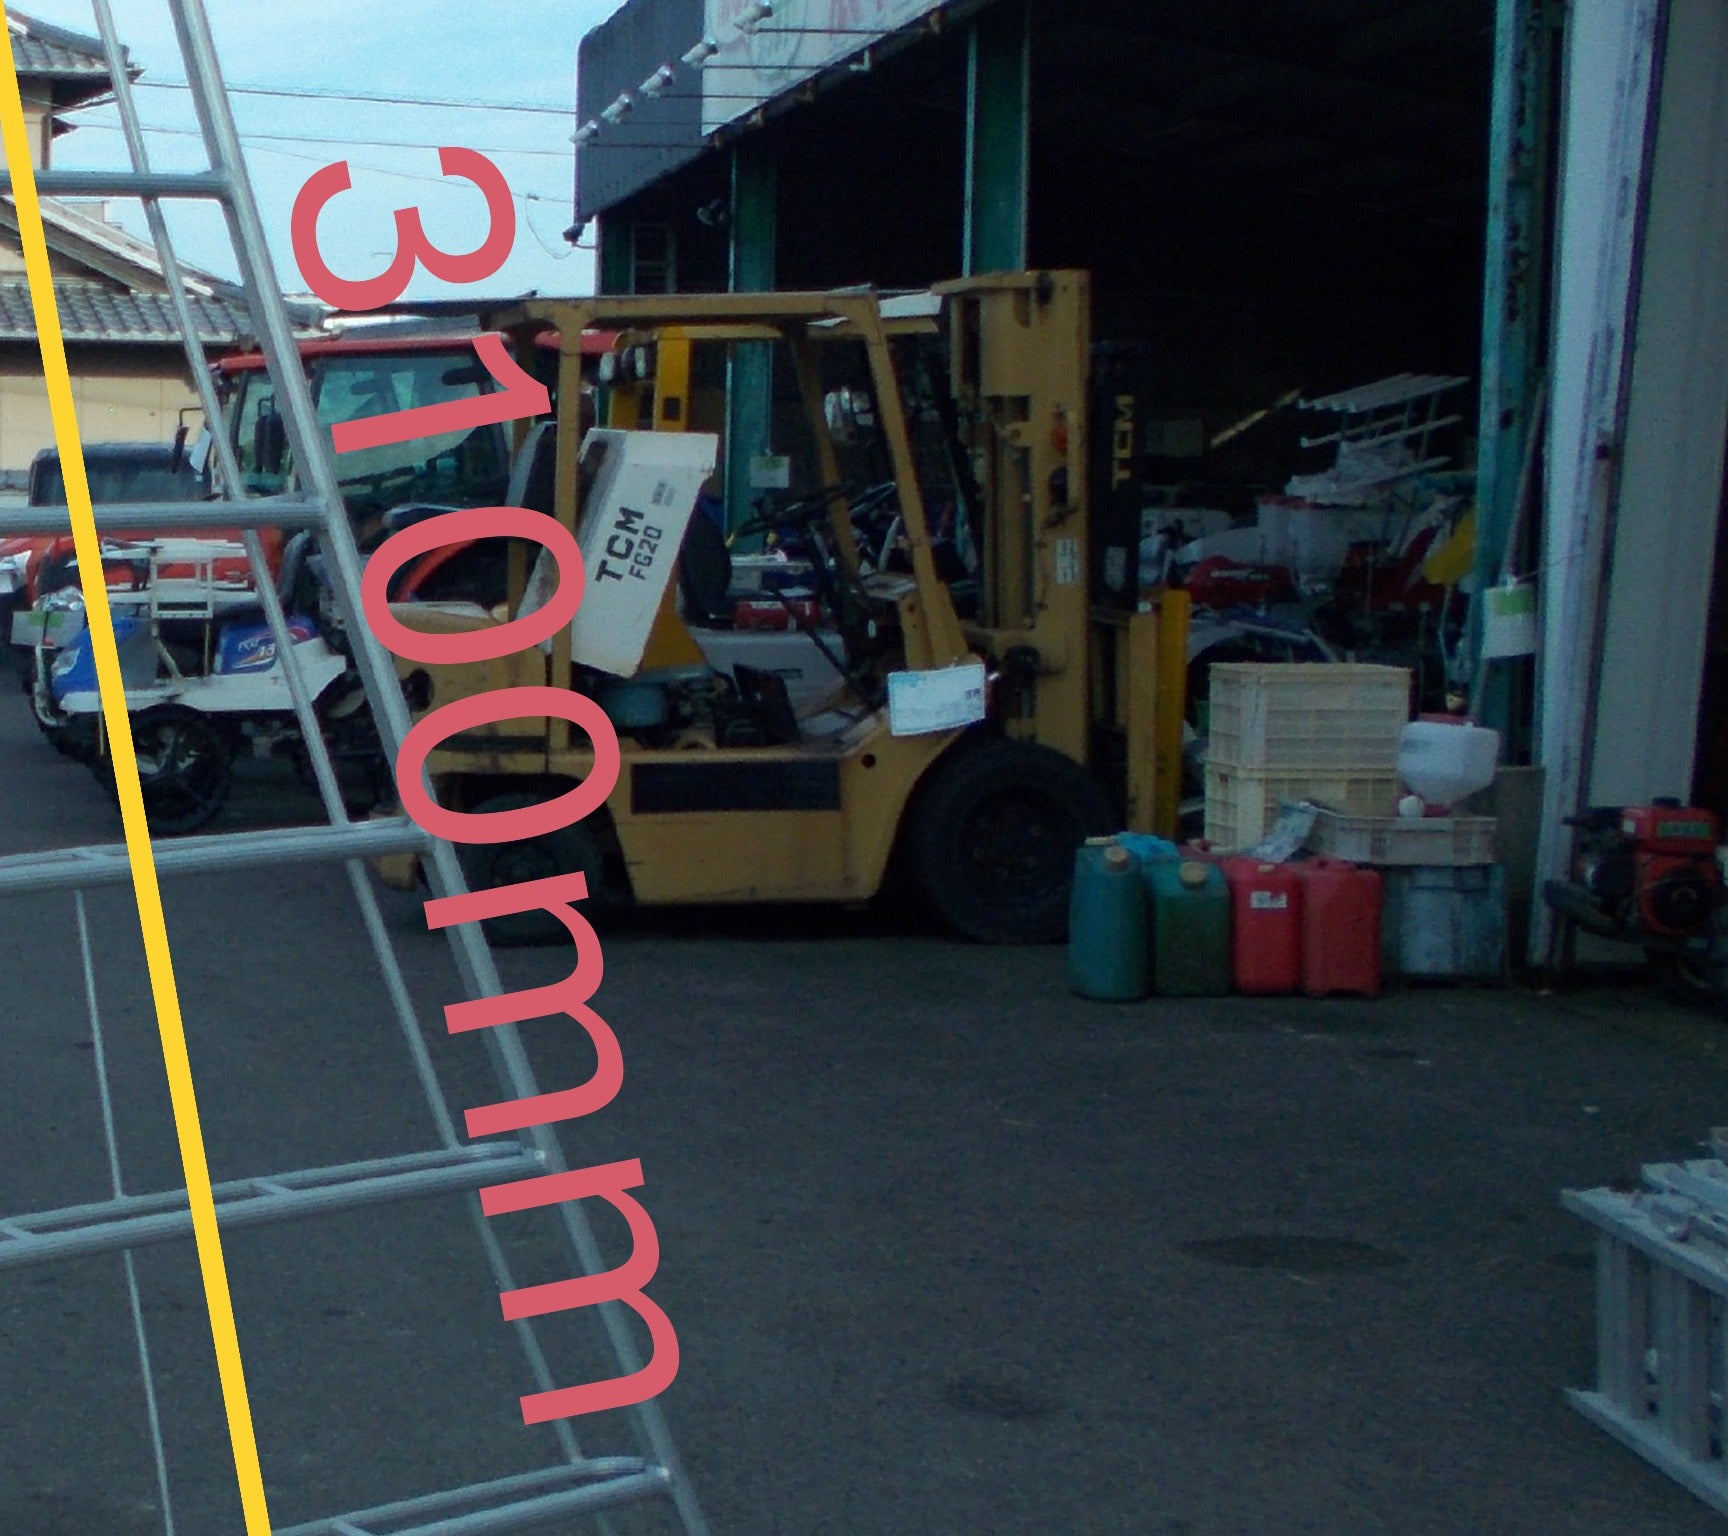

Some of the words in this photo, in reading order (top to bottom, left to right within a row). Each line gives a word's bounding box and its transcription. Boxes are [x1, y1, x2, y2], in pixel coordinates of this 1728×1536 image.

[1111, 394, 1135, 490] TCM
[594, 506, 645, 583] TCM
[628, 526, 663, 581] FG20
